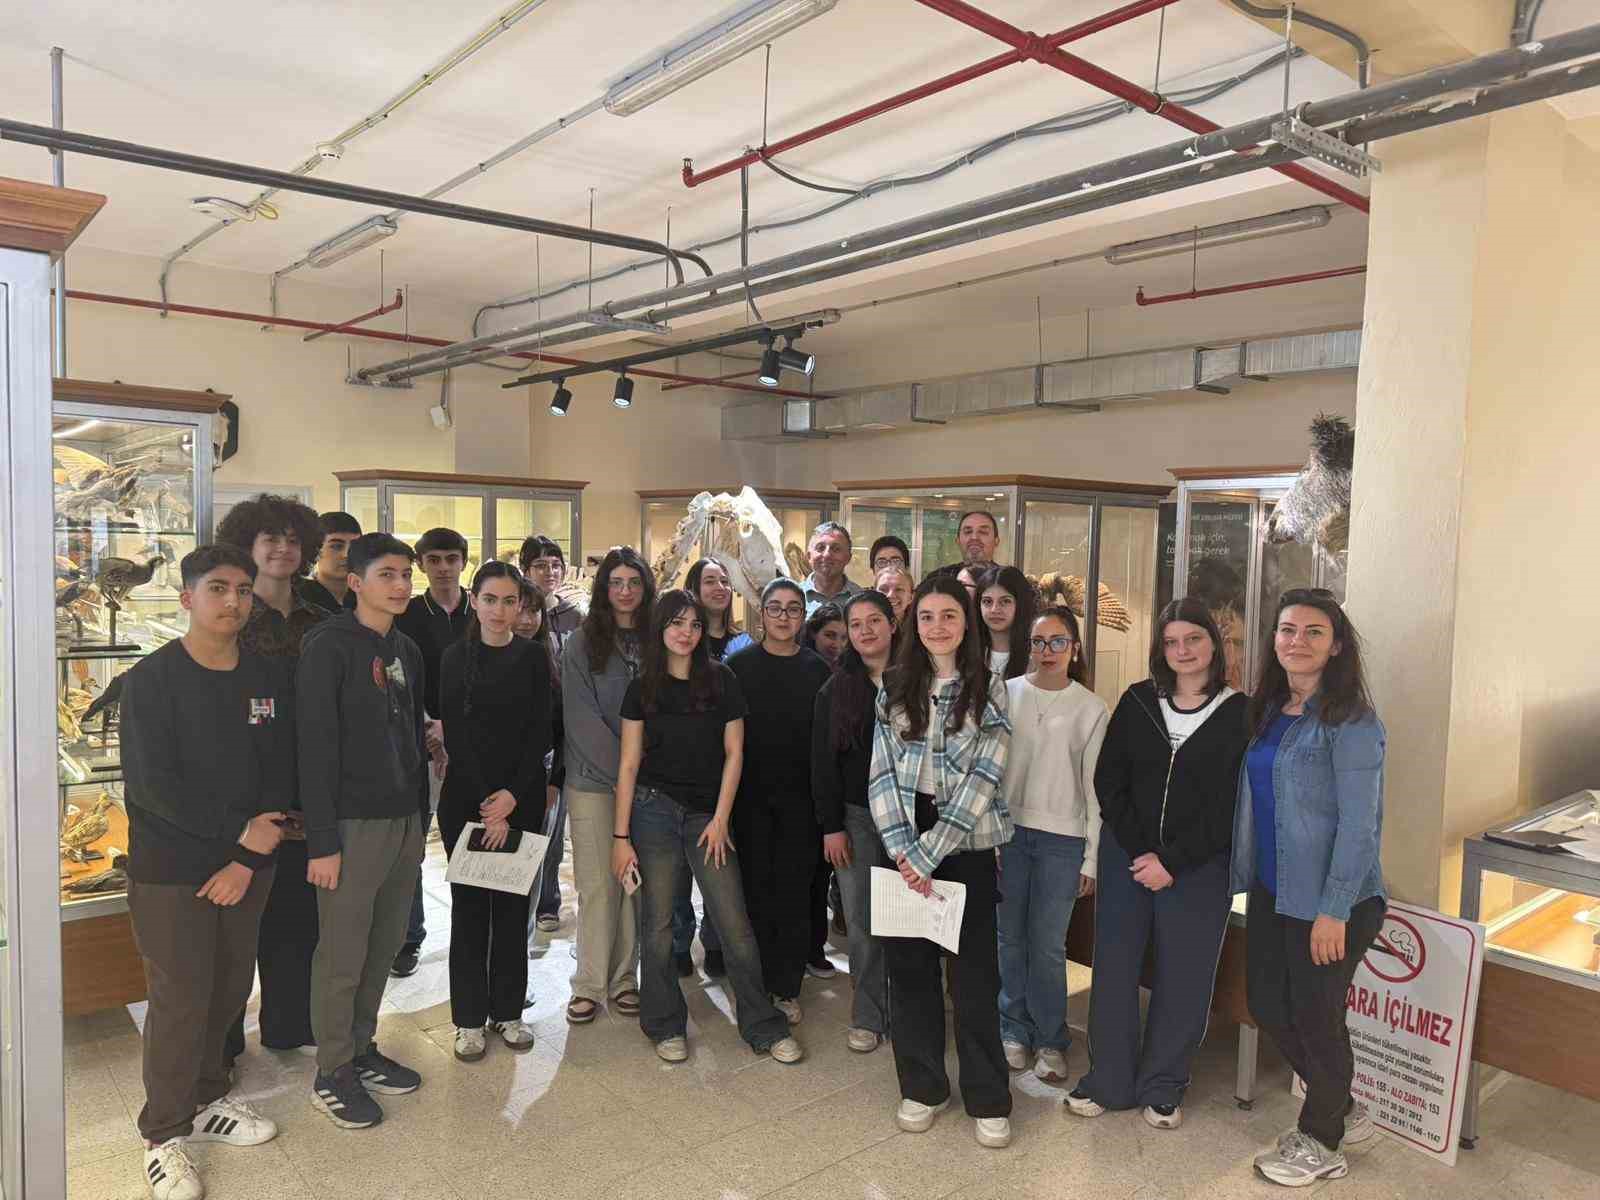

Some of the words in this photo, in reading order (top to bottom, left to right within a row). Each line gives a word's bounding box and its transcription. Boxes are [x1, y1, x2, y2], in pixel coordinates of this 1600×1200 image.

[1345, 983, 1378, 1020] ARA
[1383, 988, 1454, 1048] İÇİLMEZ
[1376, 1080, 1387, 1093] 155
[1390, 1087, 1404, 1100] ALO
[1429, 1102, 1440, 1116] 153
